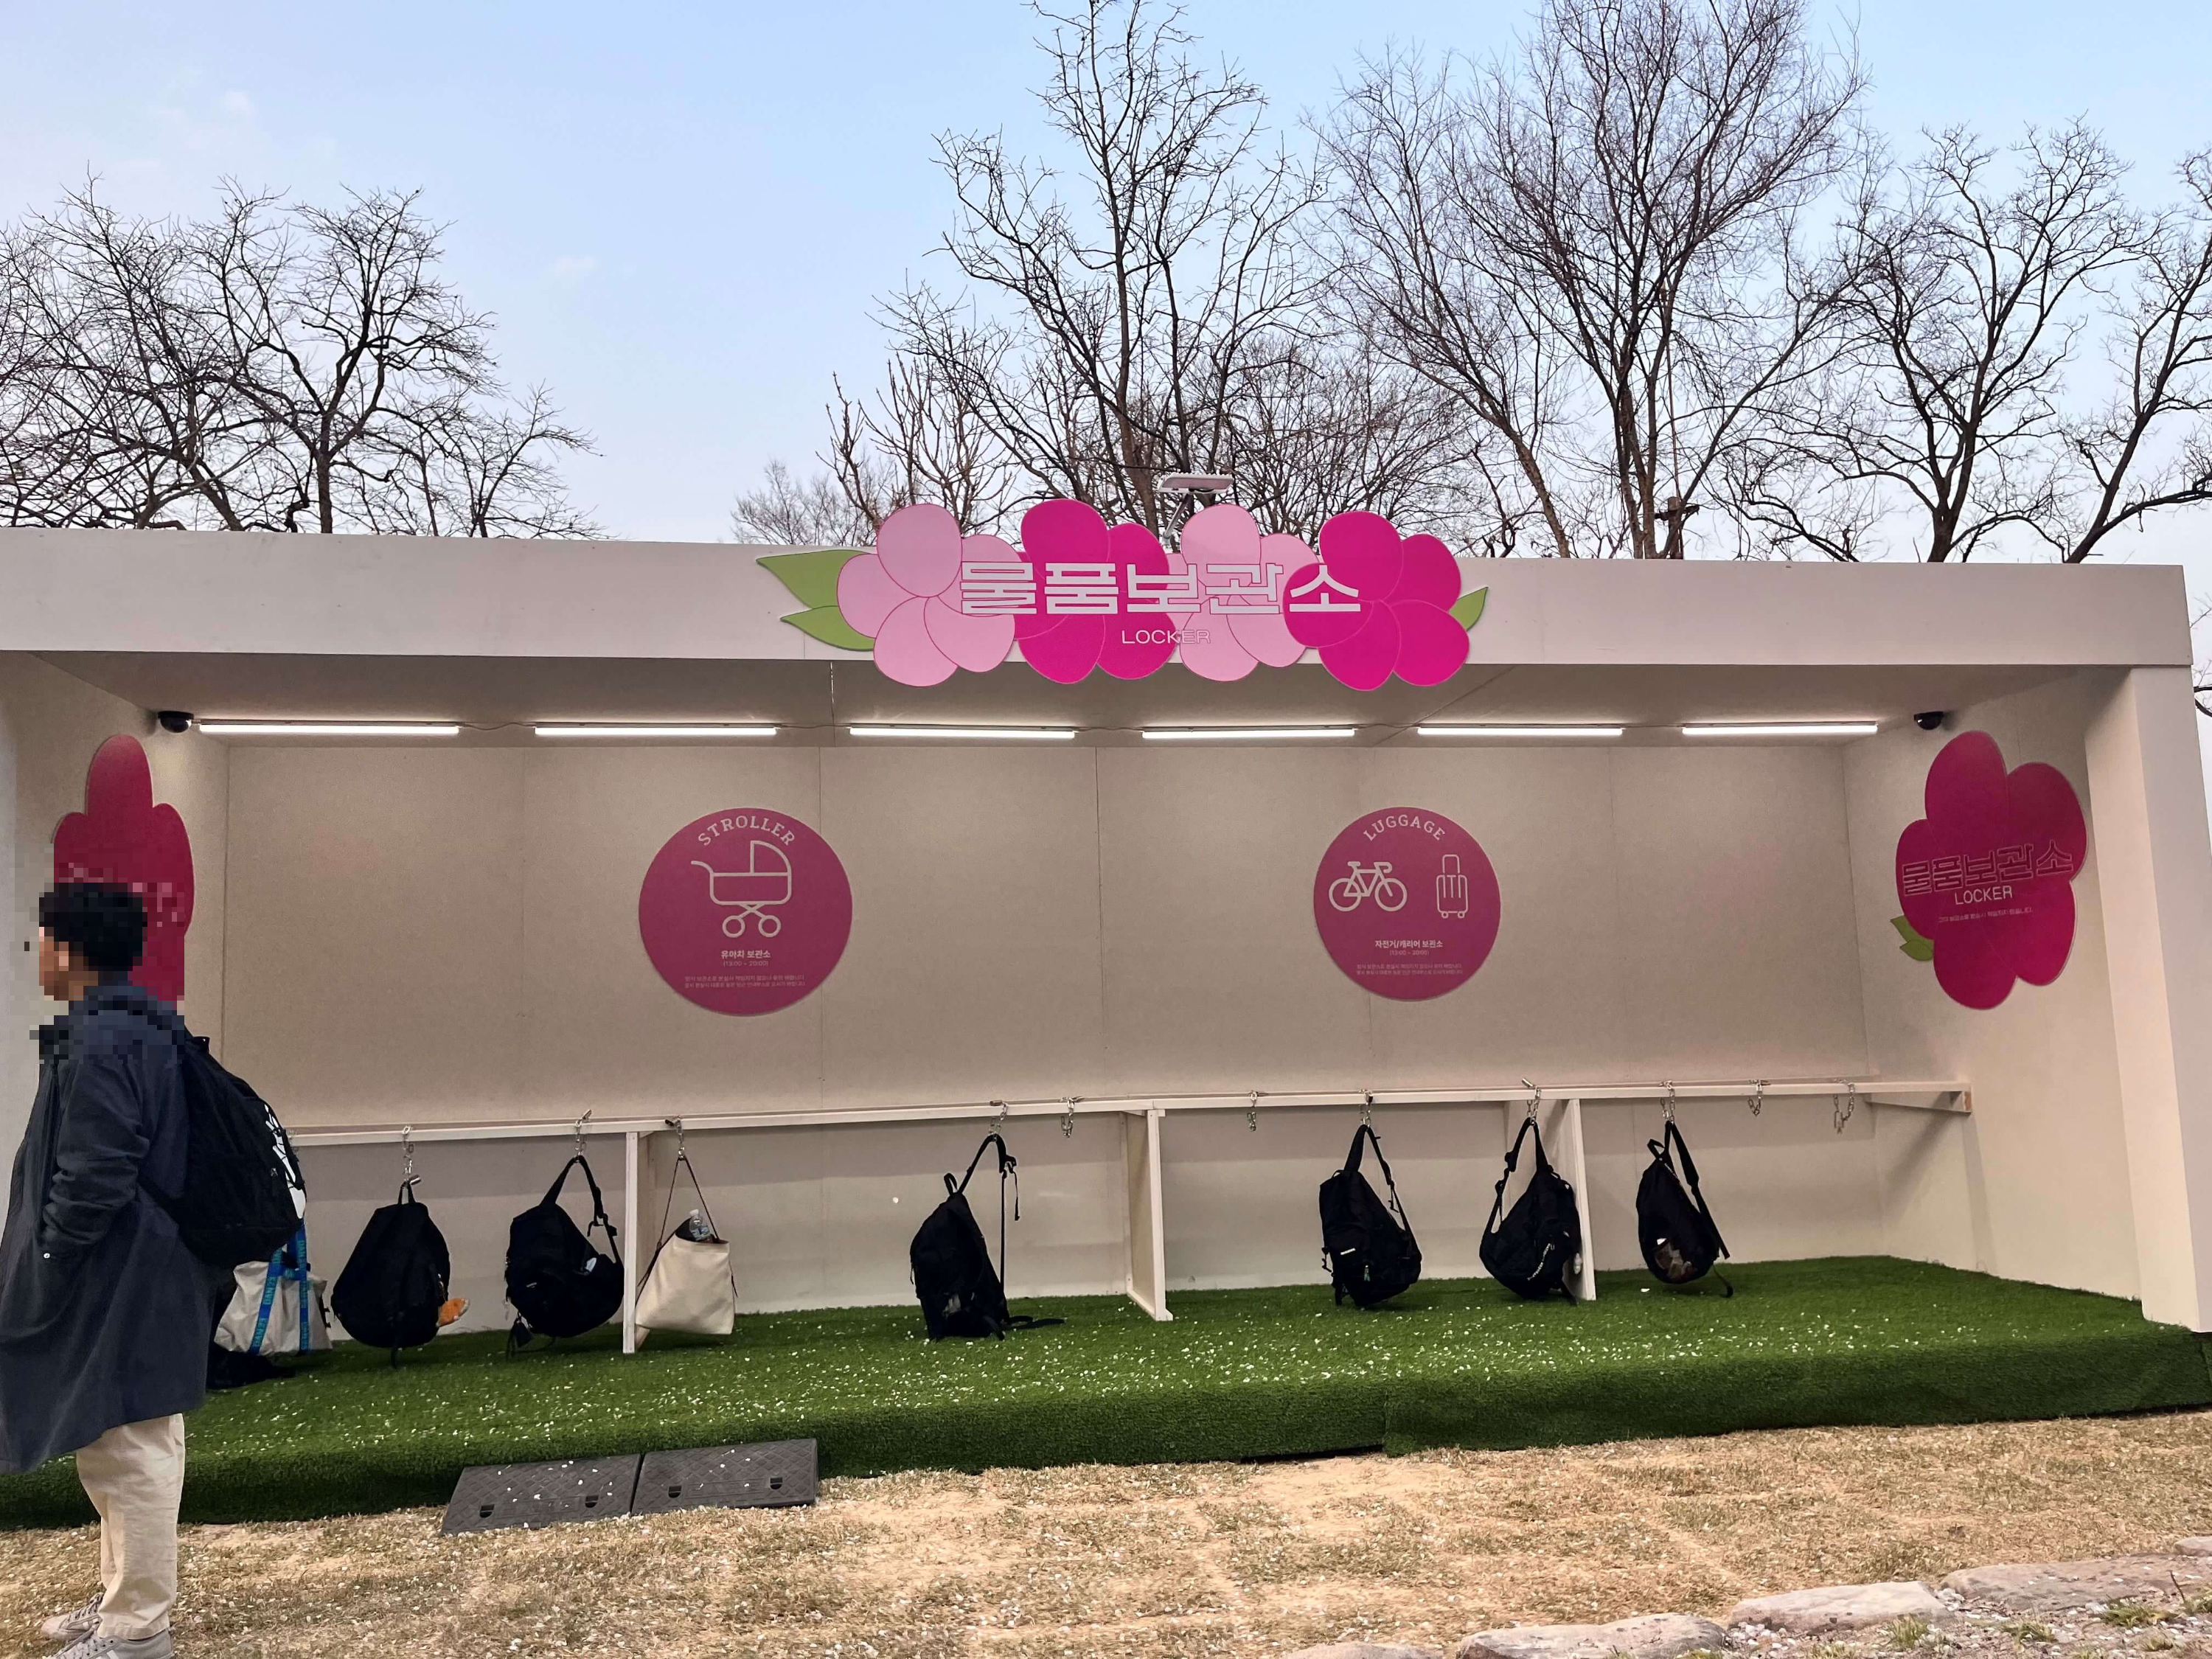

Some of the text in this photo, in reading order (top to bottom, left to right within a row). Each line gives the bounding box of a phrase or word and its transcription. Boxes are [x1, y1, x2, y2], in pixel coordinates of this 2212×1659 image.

[959, 561, 1361, 616] 물품보관소
[1121, 629, 1211, 646] LOCKER
[698, 815, 795, 846] STROLLER
[1363, 814, 1445, 841] LUGGAGE
[1902, 839, 2074, 897] 물품보관소
[1954, 885, 2013, 905] LOCKER
[720, 950, 771, 959] 유아차 보관소
[1422, 940, 1444, 948] 보관소
